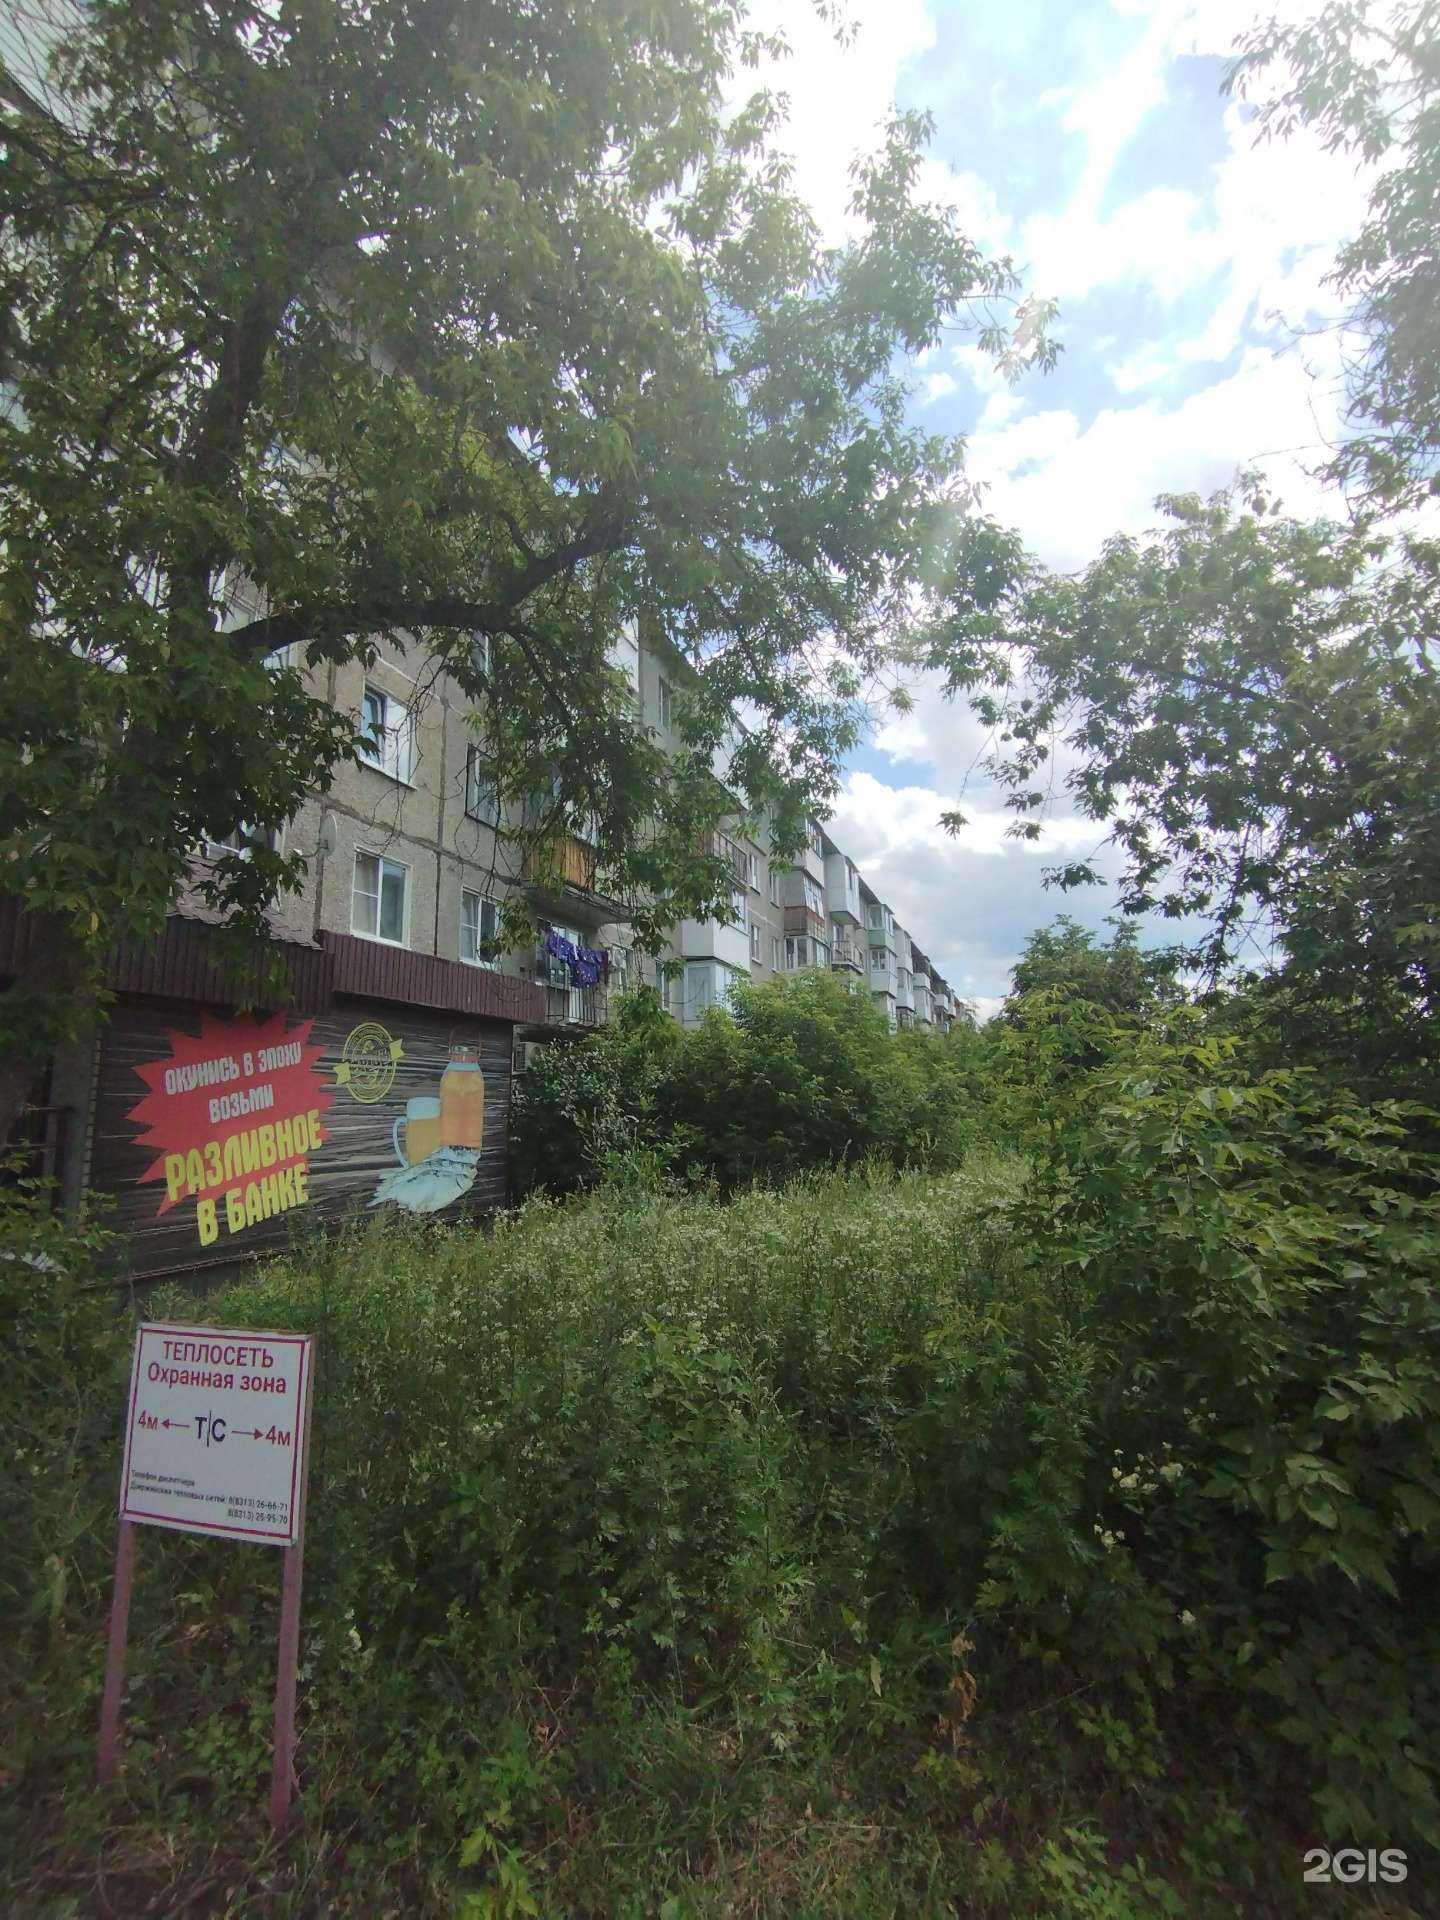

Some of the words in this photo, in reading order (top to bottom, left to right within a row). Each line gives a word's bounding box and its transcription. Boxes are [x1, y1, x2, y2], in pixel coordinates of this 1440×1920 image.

[165, 1056, 240, 1095] ОКУНИСЬ
[243, 1052, 254, 1077] В
[208, 1084, 275, 1124] ВОЗЬМИ
[165, 1109, 322, 1201] РАЗЛИВНОЕ
[197, 1198, 219, 1247] В
[226, 1162, 309, 1234] БАНКЕ
[163, 1341, 274, 1368] ТЕПЛОСЕТЬ
[148, 1362, 234, 1389] Охранная
[240, 1375, 286, 1394] зона
[138, 1410, 159, 1431] 4м
[265, 1425, 291, 1447] 4м
